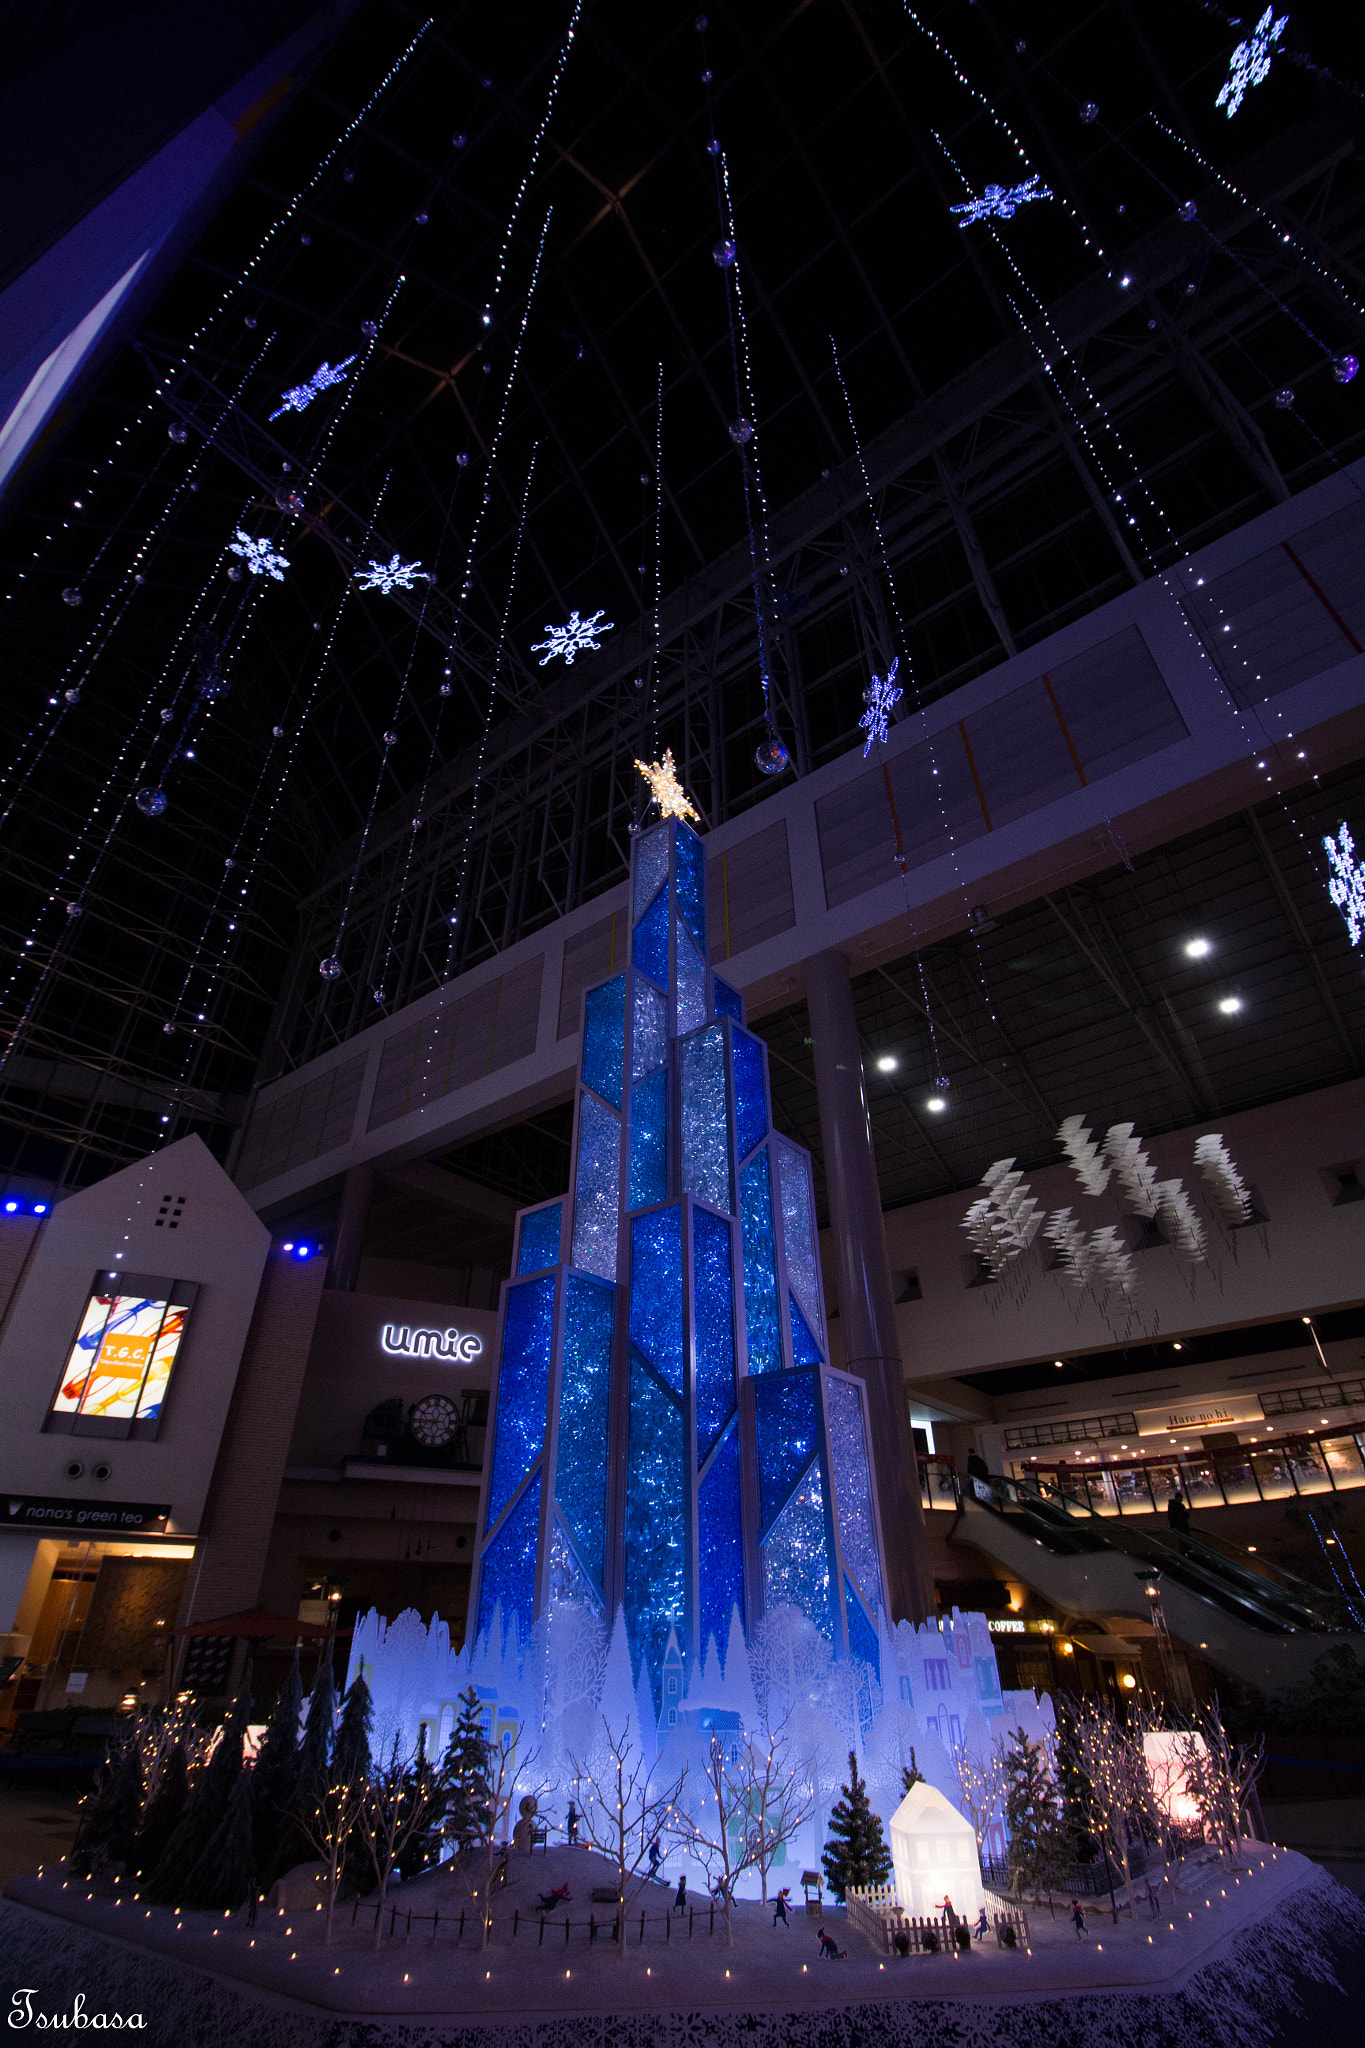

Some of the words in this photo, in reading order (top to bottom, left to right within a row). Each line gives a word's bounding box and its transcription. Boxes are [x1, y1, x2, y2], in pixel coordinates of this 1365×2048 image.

[382, 1325, 482, 1362] umie
[1168, 1415, 1197, 1425] Hare
[1199, 1412, 1213, 1421] no
[1214, 1407, 1228, 1418] hi
[76, 1510, 117, 1523] green
[121, 1511, 143, 1524] tea
[988, 1620, 1026, 1632] COFFEE
